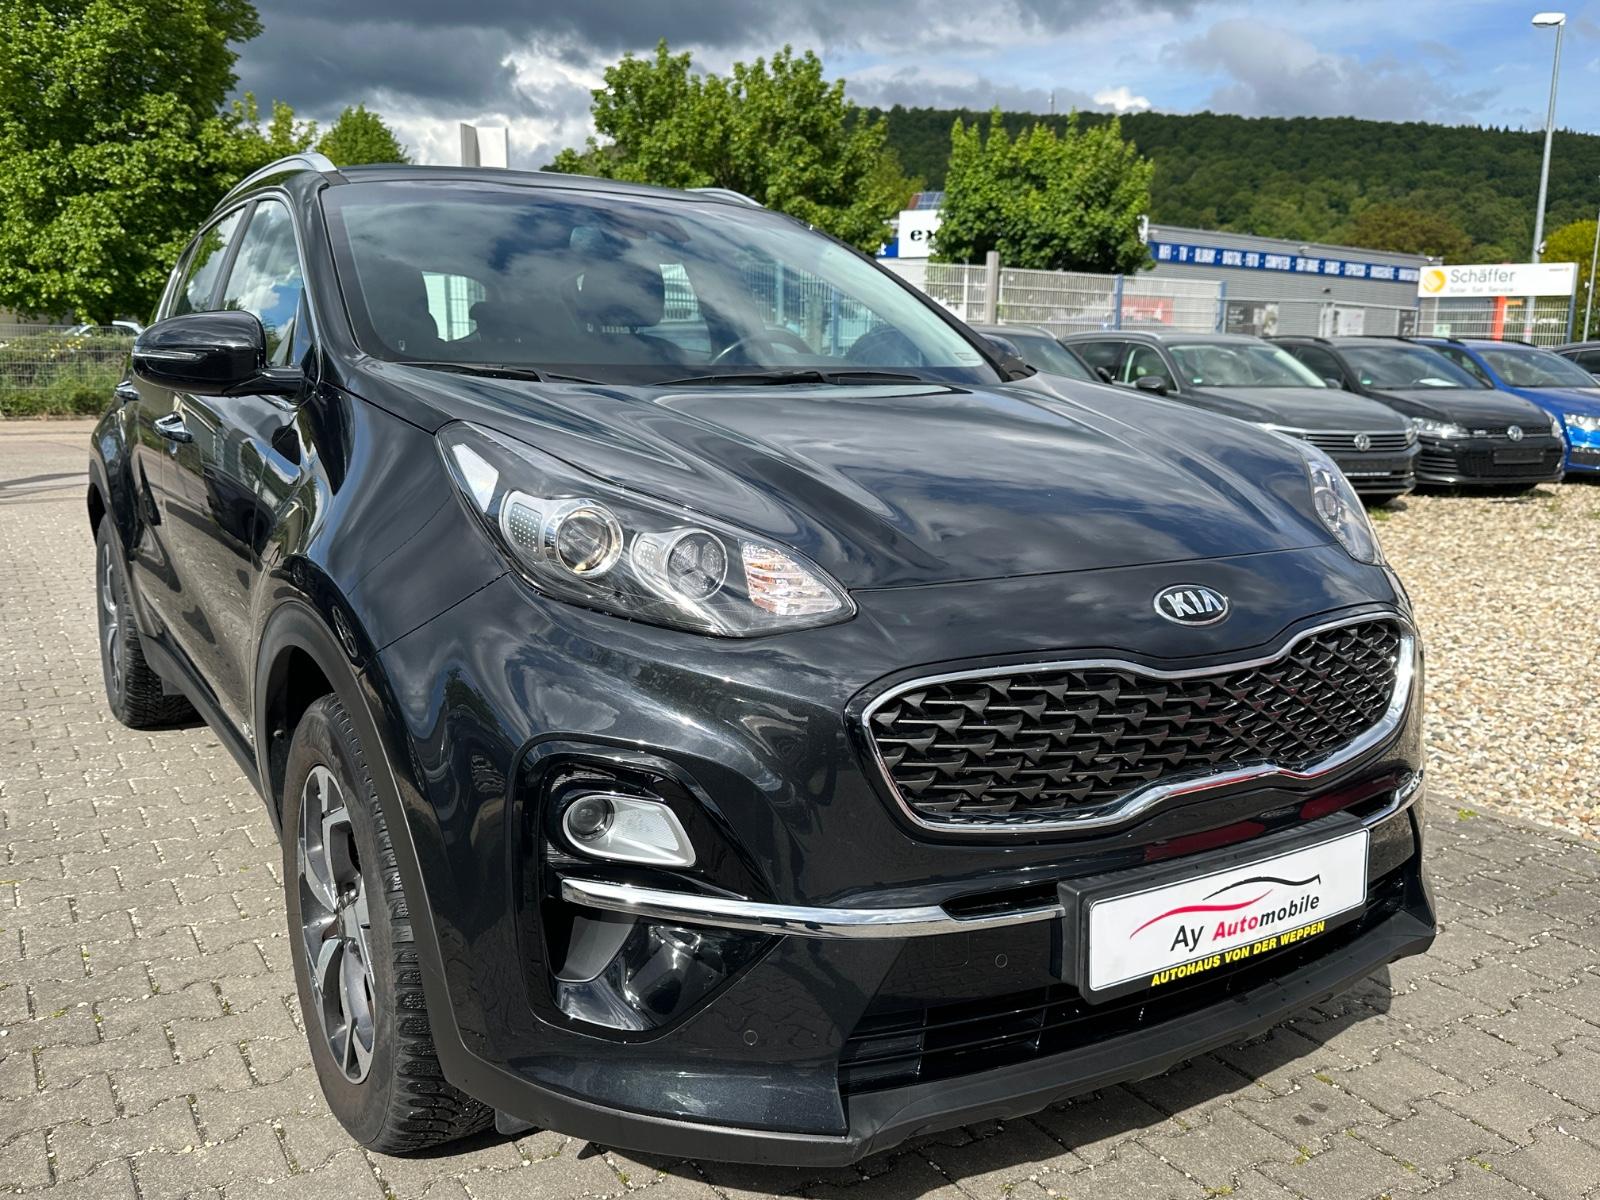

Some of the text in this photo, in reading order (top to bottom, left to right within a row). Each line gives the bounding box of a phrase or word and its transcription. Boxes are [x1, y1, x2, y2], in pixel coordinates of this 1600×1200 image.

[1450, 268, 1516, 283] Schäffer
[1163, 589, 1224, 618] KIA
[1170, 894, 1320, 952] Ay Automobile
[1151, 921, 1326, 987] AUTOHAUS VON DER WEPPEN
